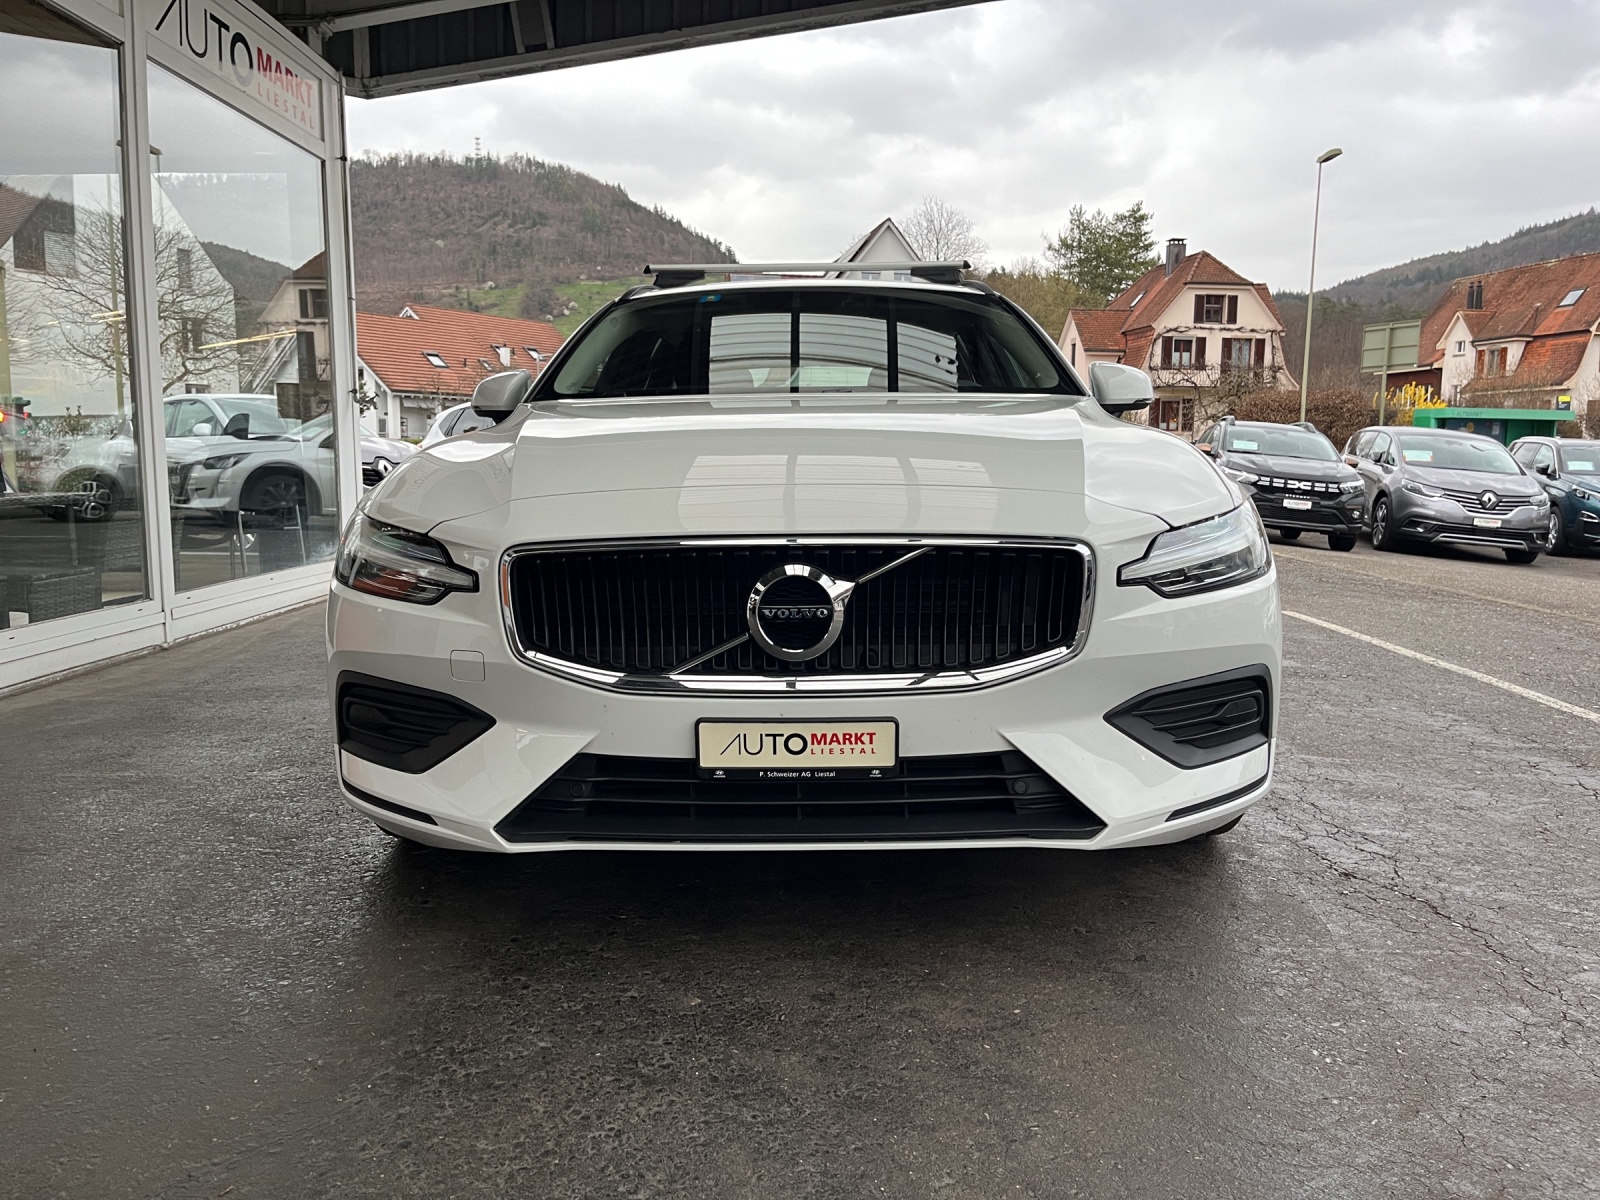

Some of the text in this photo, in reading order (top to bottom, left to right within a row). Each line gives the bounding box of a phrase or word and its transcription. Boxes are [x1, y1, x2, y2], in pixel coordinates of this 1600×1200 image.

[257, 46, 313, 108] MARKT
[257, 83, 314, 130] LIESTAL
[762, 608, 829, 619] VOLVO
[810, 732, 877, 746] MARKT
